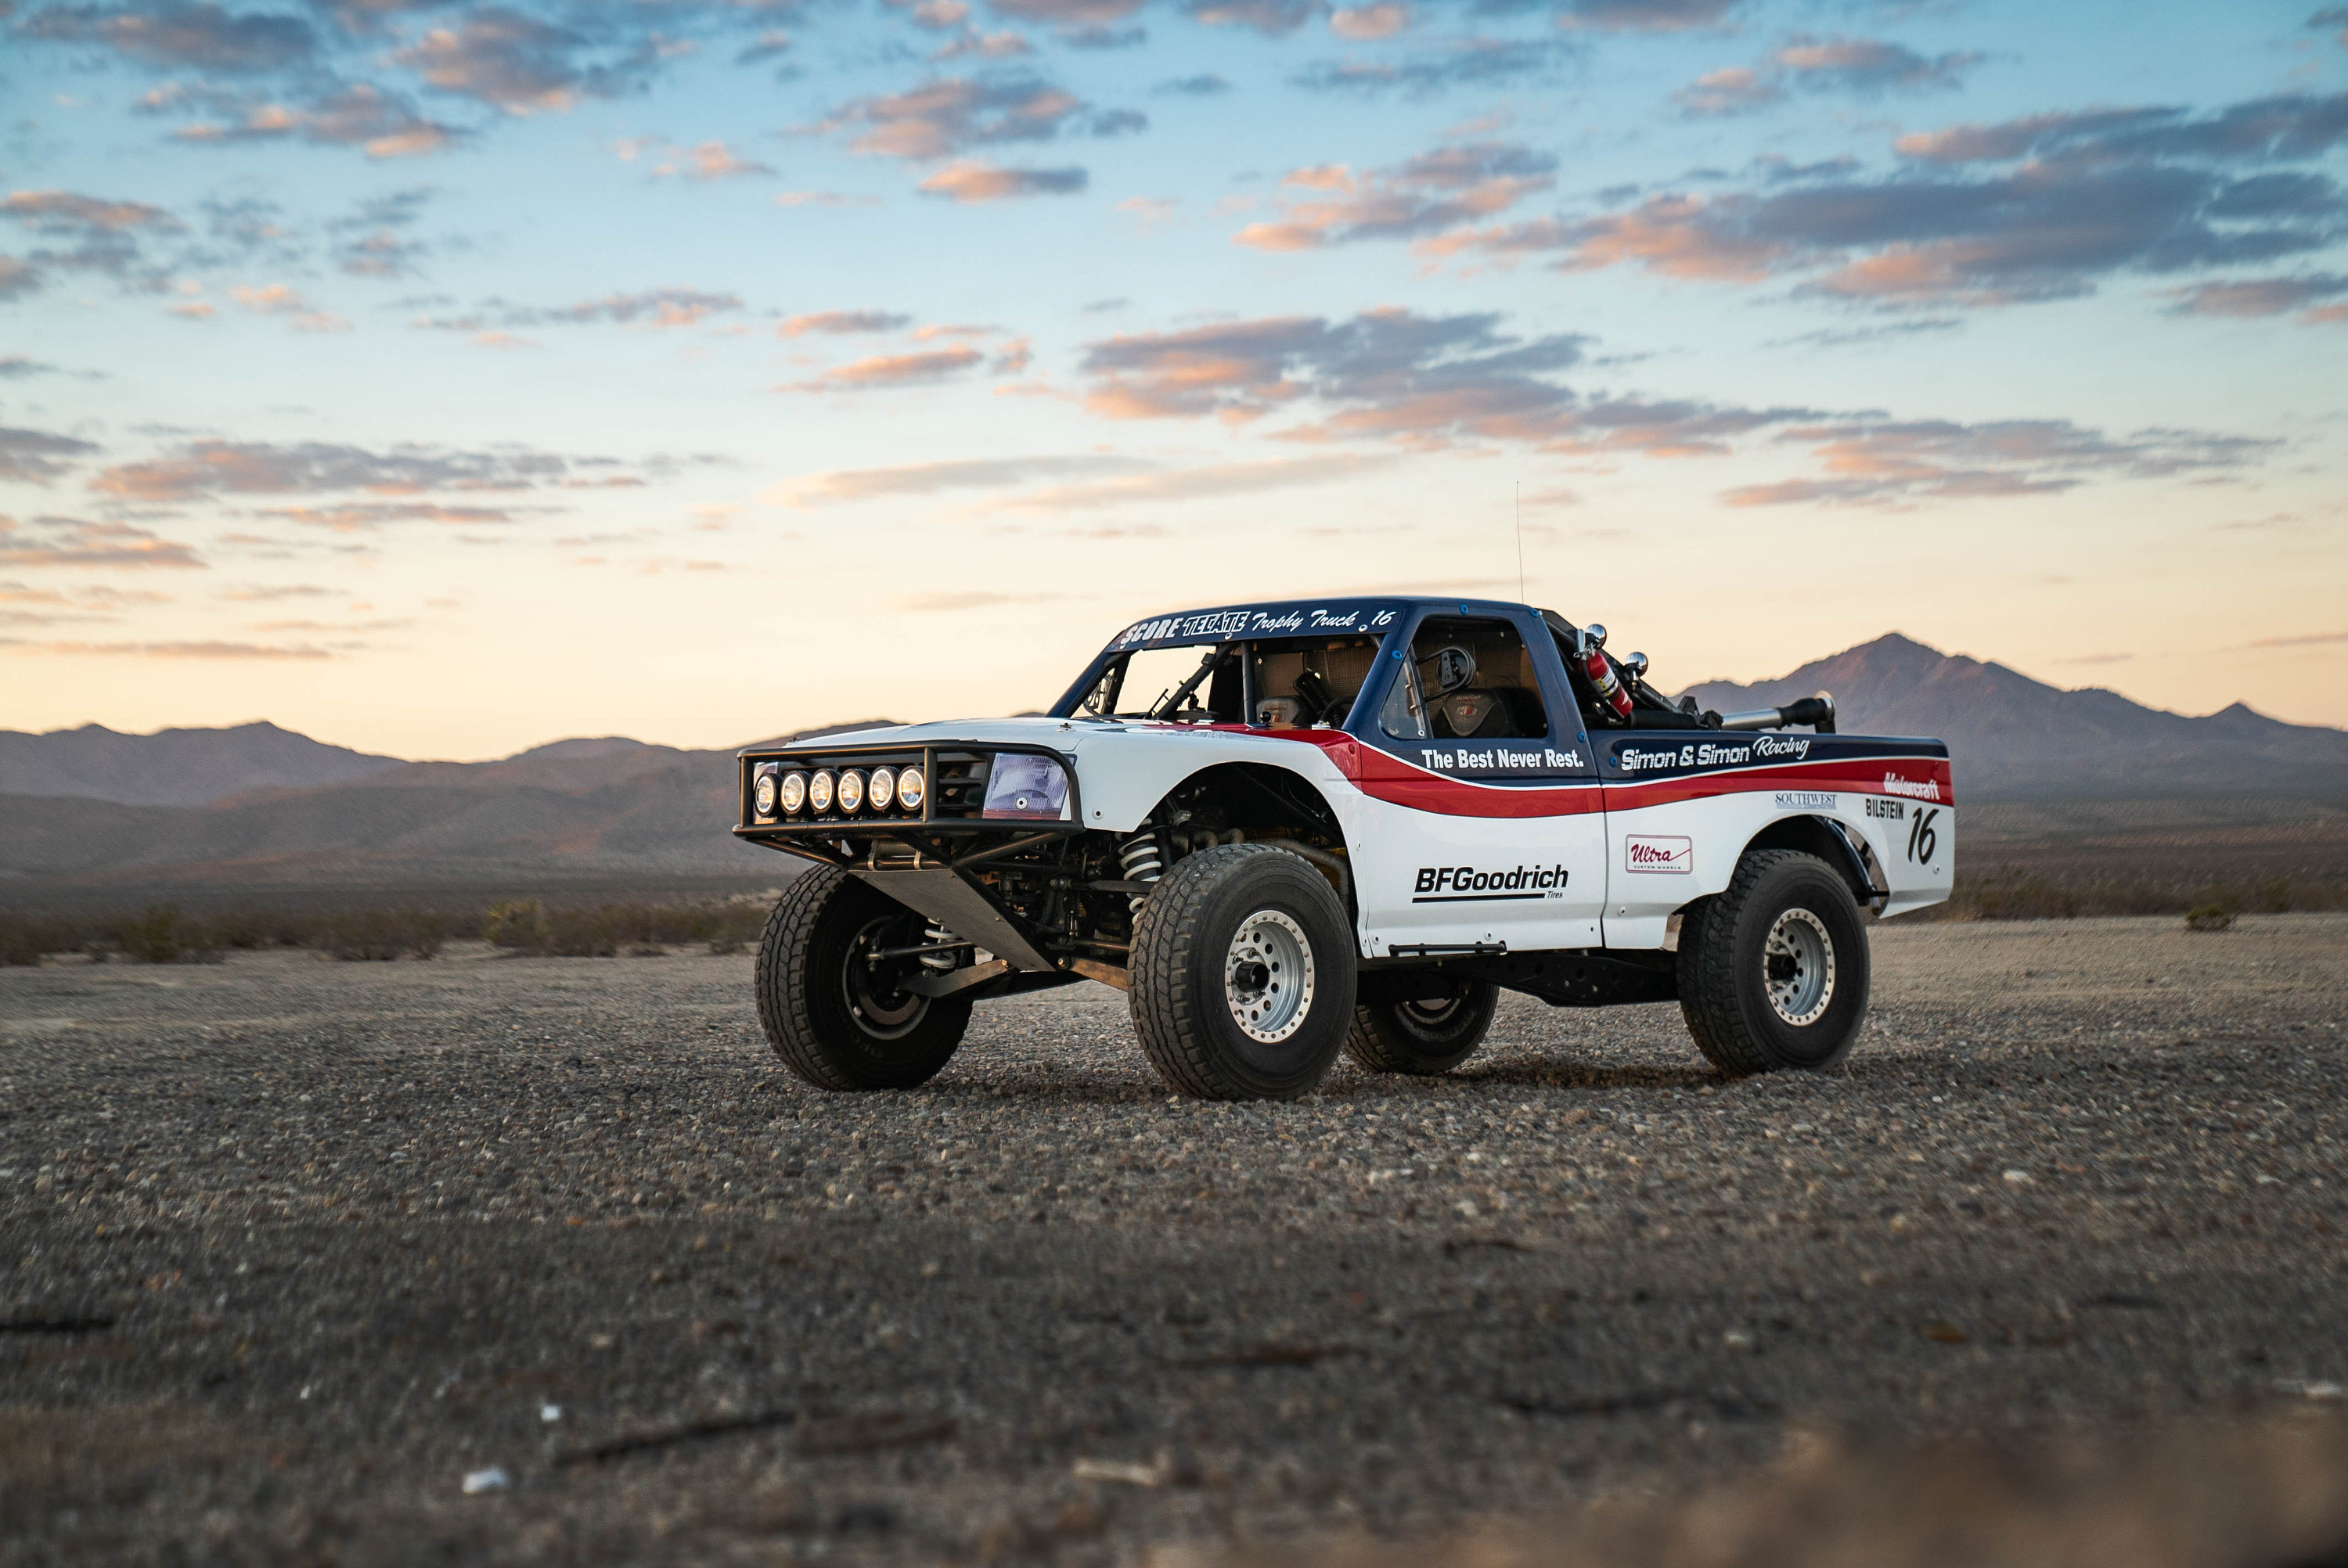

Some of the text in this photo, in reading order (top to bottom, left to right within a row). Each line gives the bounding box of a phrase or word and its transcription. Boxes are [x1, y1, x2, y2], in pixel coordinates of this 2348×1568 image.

[1120, 610, 1396, 649] SCORE TECATE Trophy Truck 16
[1421, 748, 1584, 768] The Best Never Rest.
[1621, 735, 1810, 771] Simon & Simon Racing
[1883, 771, 1940, 800] Motorcraft
[1775, 793, 1837, 804] SOUTHWEST
[1866, 798, 1904, 820] BILSTEIN
[1907, 807, 1939, 865] 16
[1630, 843, 1690, 863] Ultra
[1414, 864, 1568, 893] BFGoodrich
[1547, 890, 1563, 899] Tires
